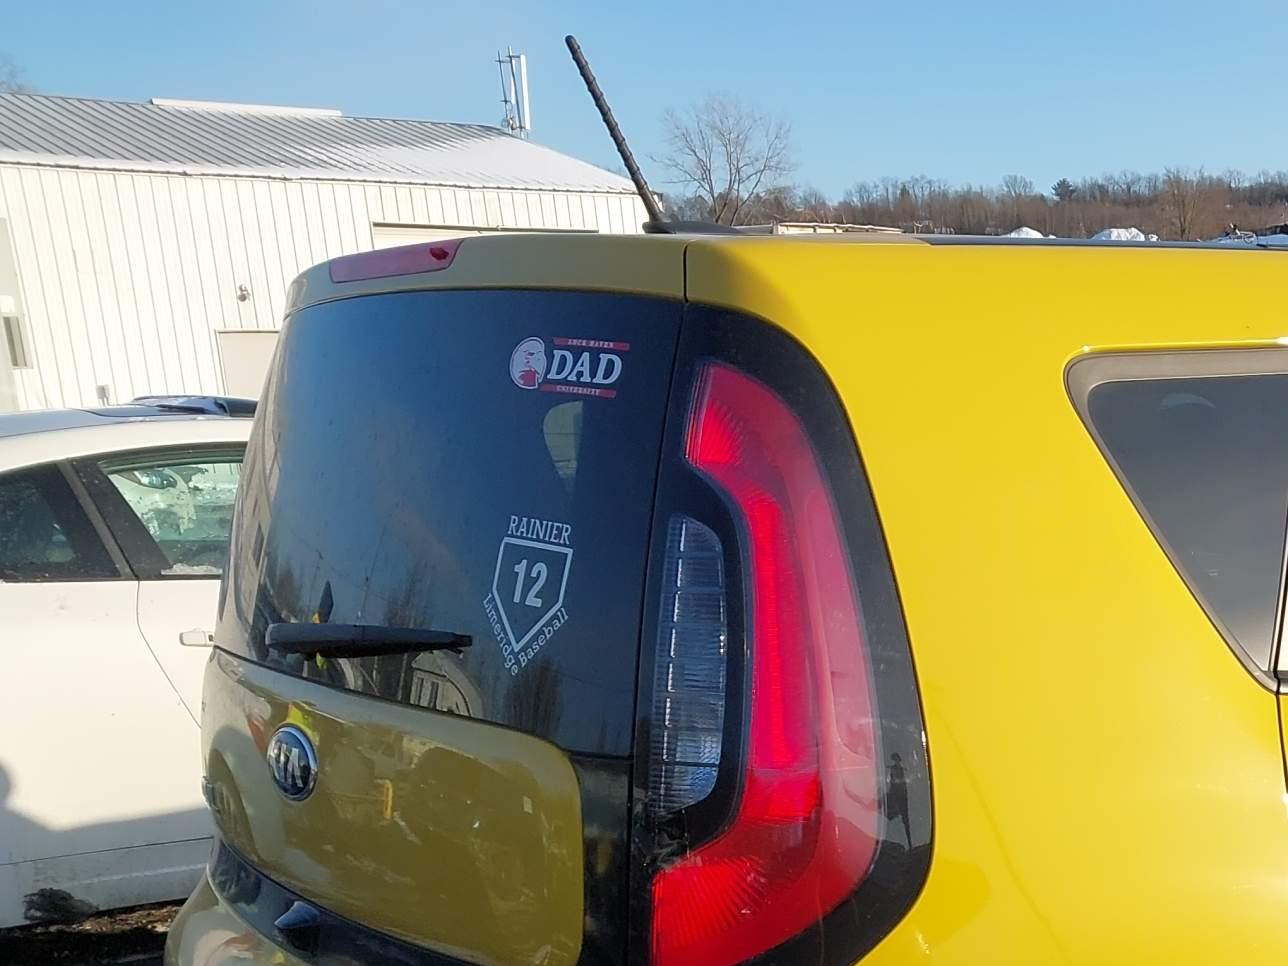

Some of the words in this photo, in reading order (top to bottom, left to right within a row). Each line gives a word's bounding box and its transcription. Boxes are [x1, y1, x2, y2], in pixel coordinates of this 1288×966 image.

[546, 349, 623, 385] DAD
[507, 515, 572, 545] RAINIER
[513, 559, 548, 608] 12
[483, 592, 519, 676] Limeridge
[517, 607, 569, 668] Baseball
